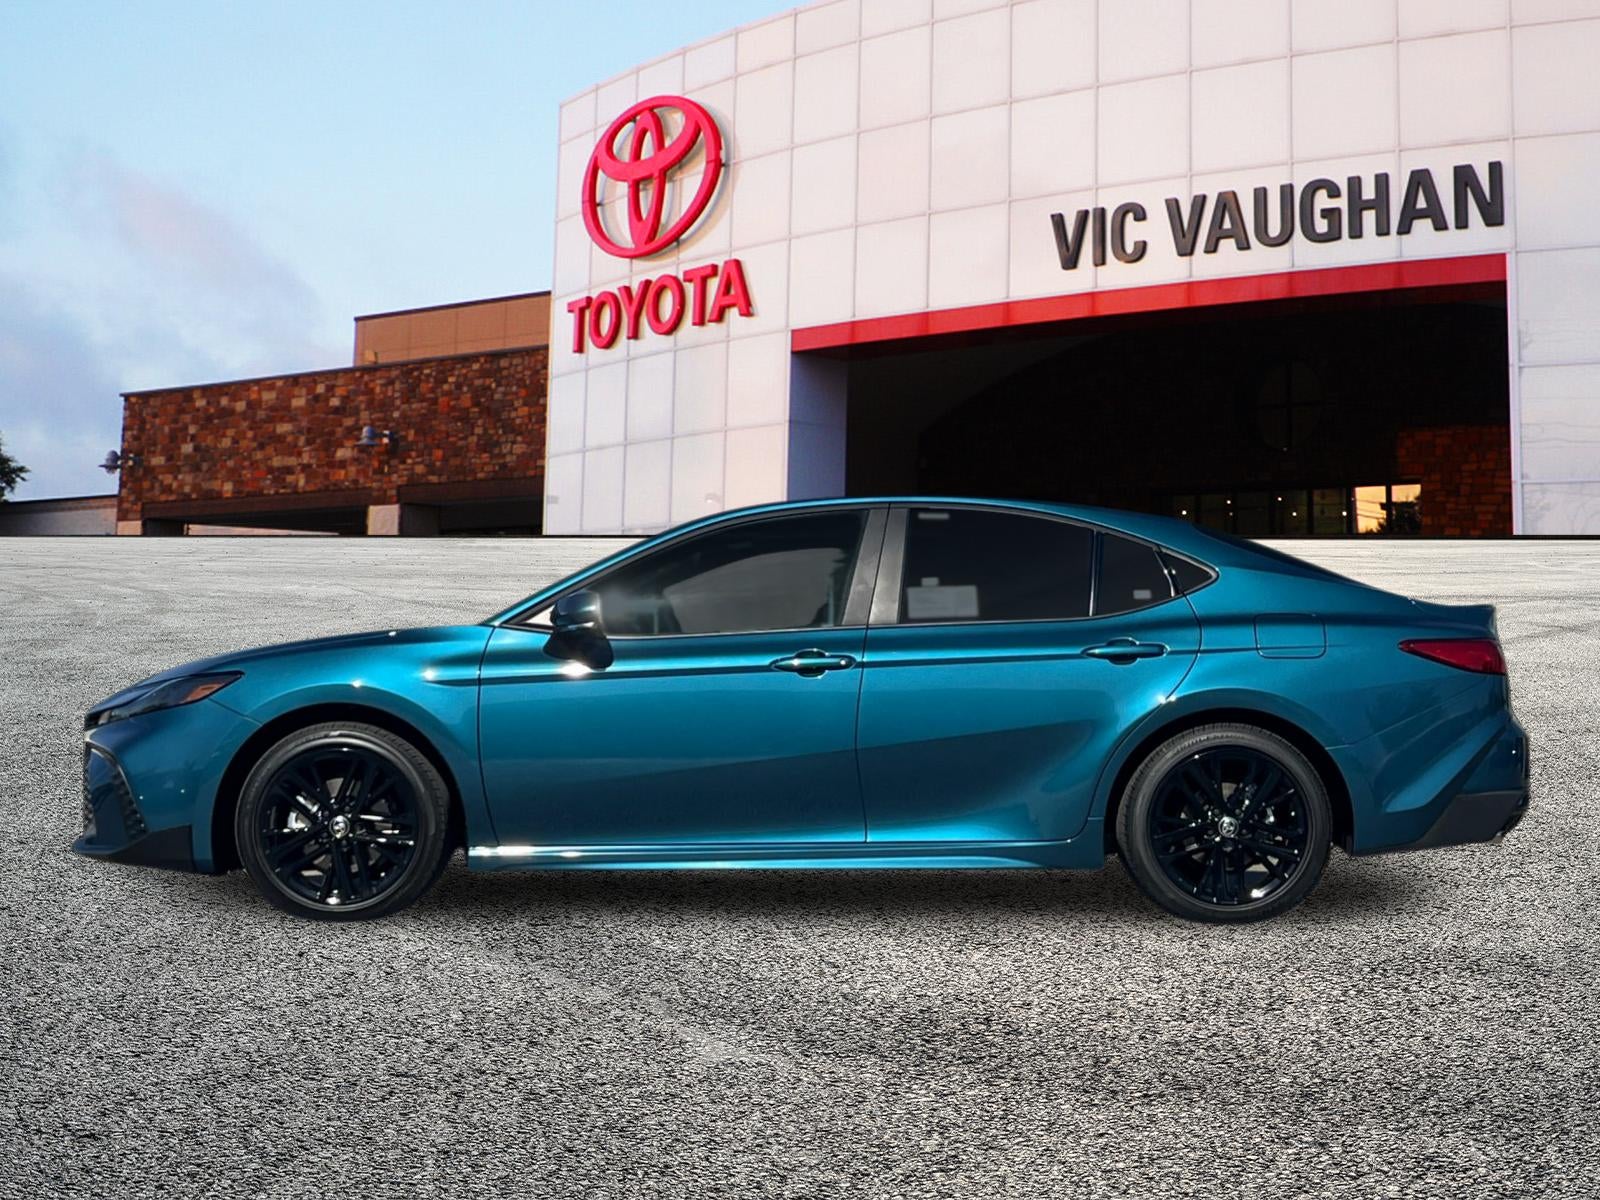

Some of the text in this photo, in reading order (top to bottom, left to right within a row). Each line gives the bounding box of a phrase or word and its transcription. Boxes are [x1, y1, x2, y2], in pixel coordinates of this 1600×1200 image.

[1051, 161, 1504, 270] VIC VAUGHAN
[567, 259, 753, 353] TOYOTA
